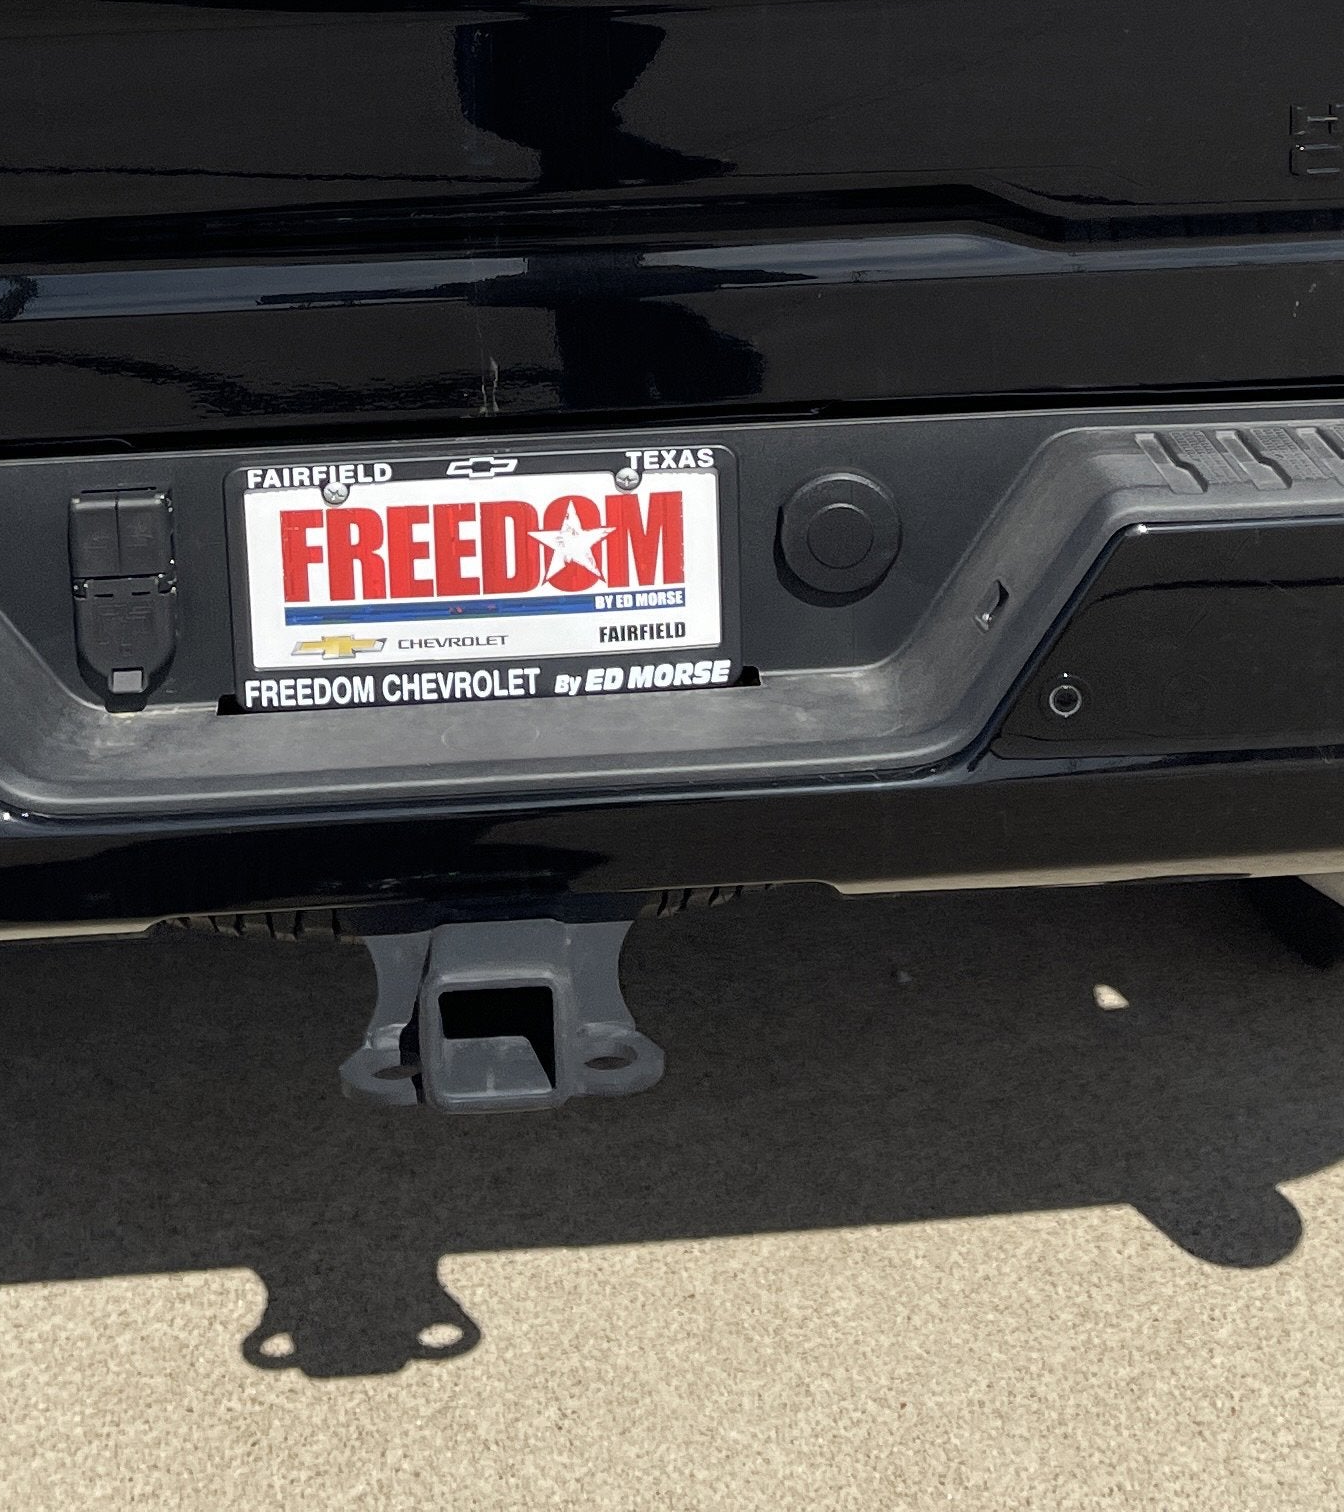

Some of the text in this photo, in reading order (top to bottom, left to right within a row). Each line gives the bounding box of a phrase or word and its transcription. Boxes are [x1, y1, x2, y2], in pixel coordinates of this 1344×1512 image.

[247, 448, 714, 488] FAIRFIELD TEXAS
[280, 491, 685, 602] FREEDOM
[594, 590, 684, 610] BY ED MORSE
[398, 635, 509, 650] CHEVROLET
[599, 621, 686, 643] FAIRFIELD
[244, 659, 731, 708] FREEDOM CHEVROLET By ED MORSE
